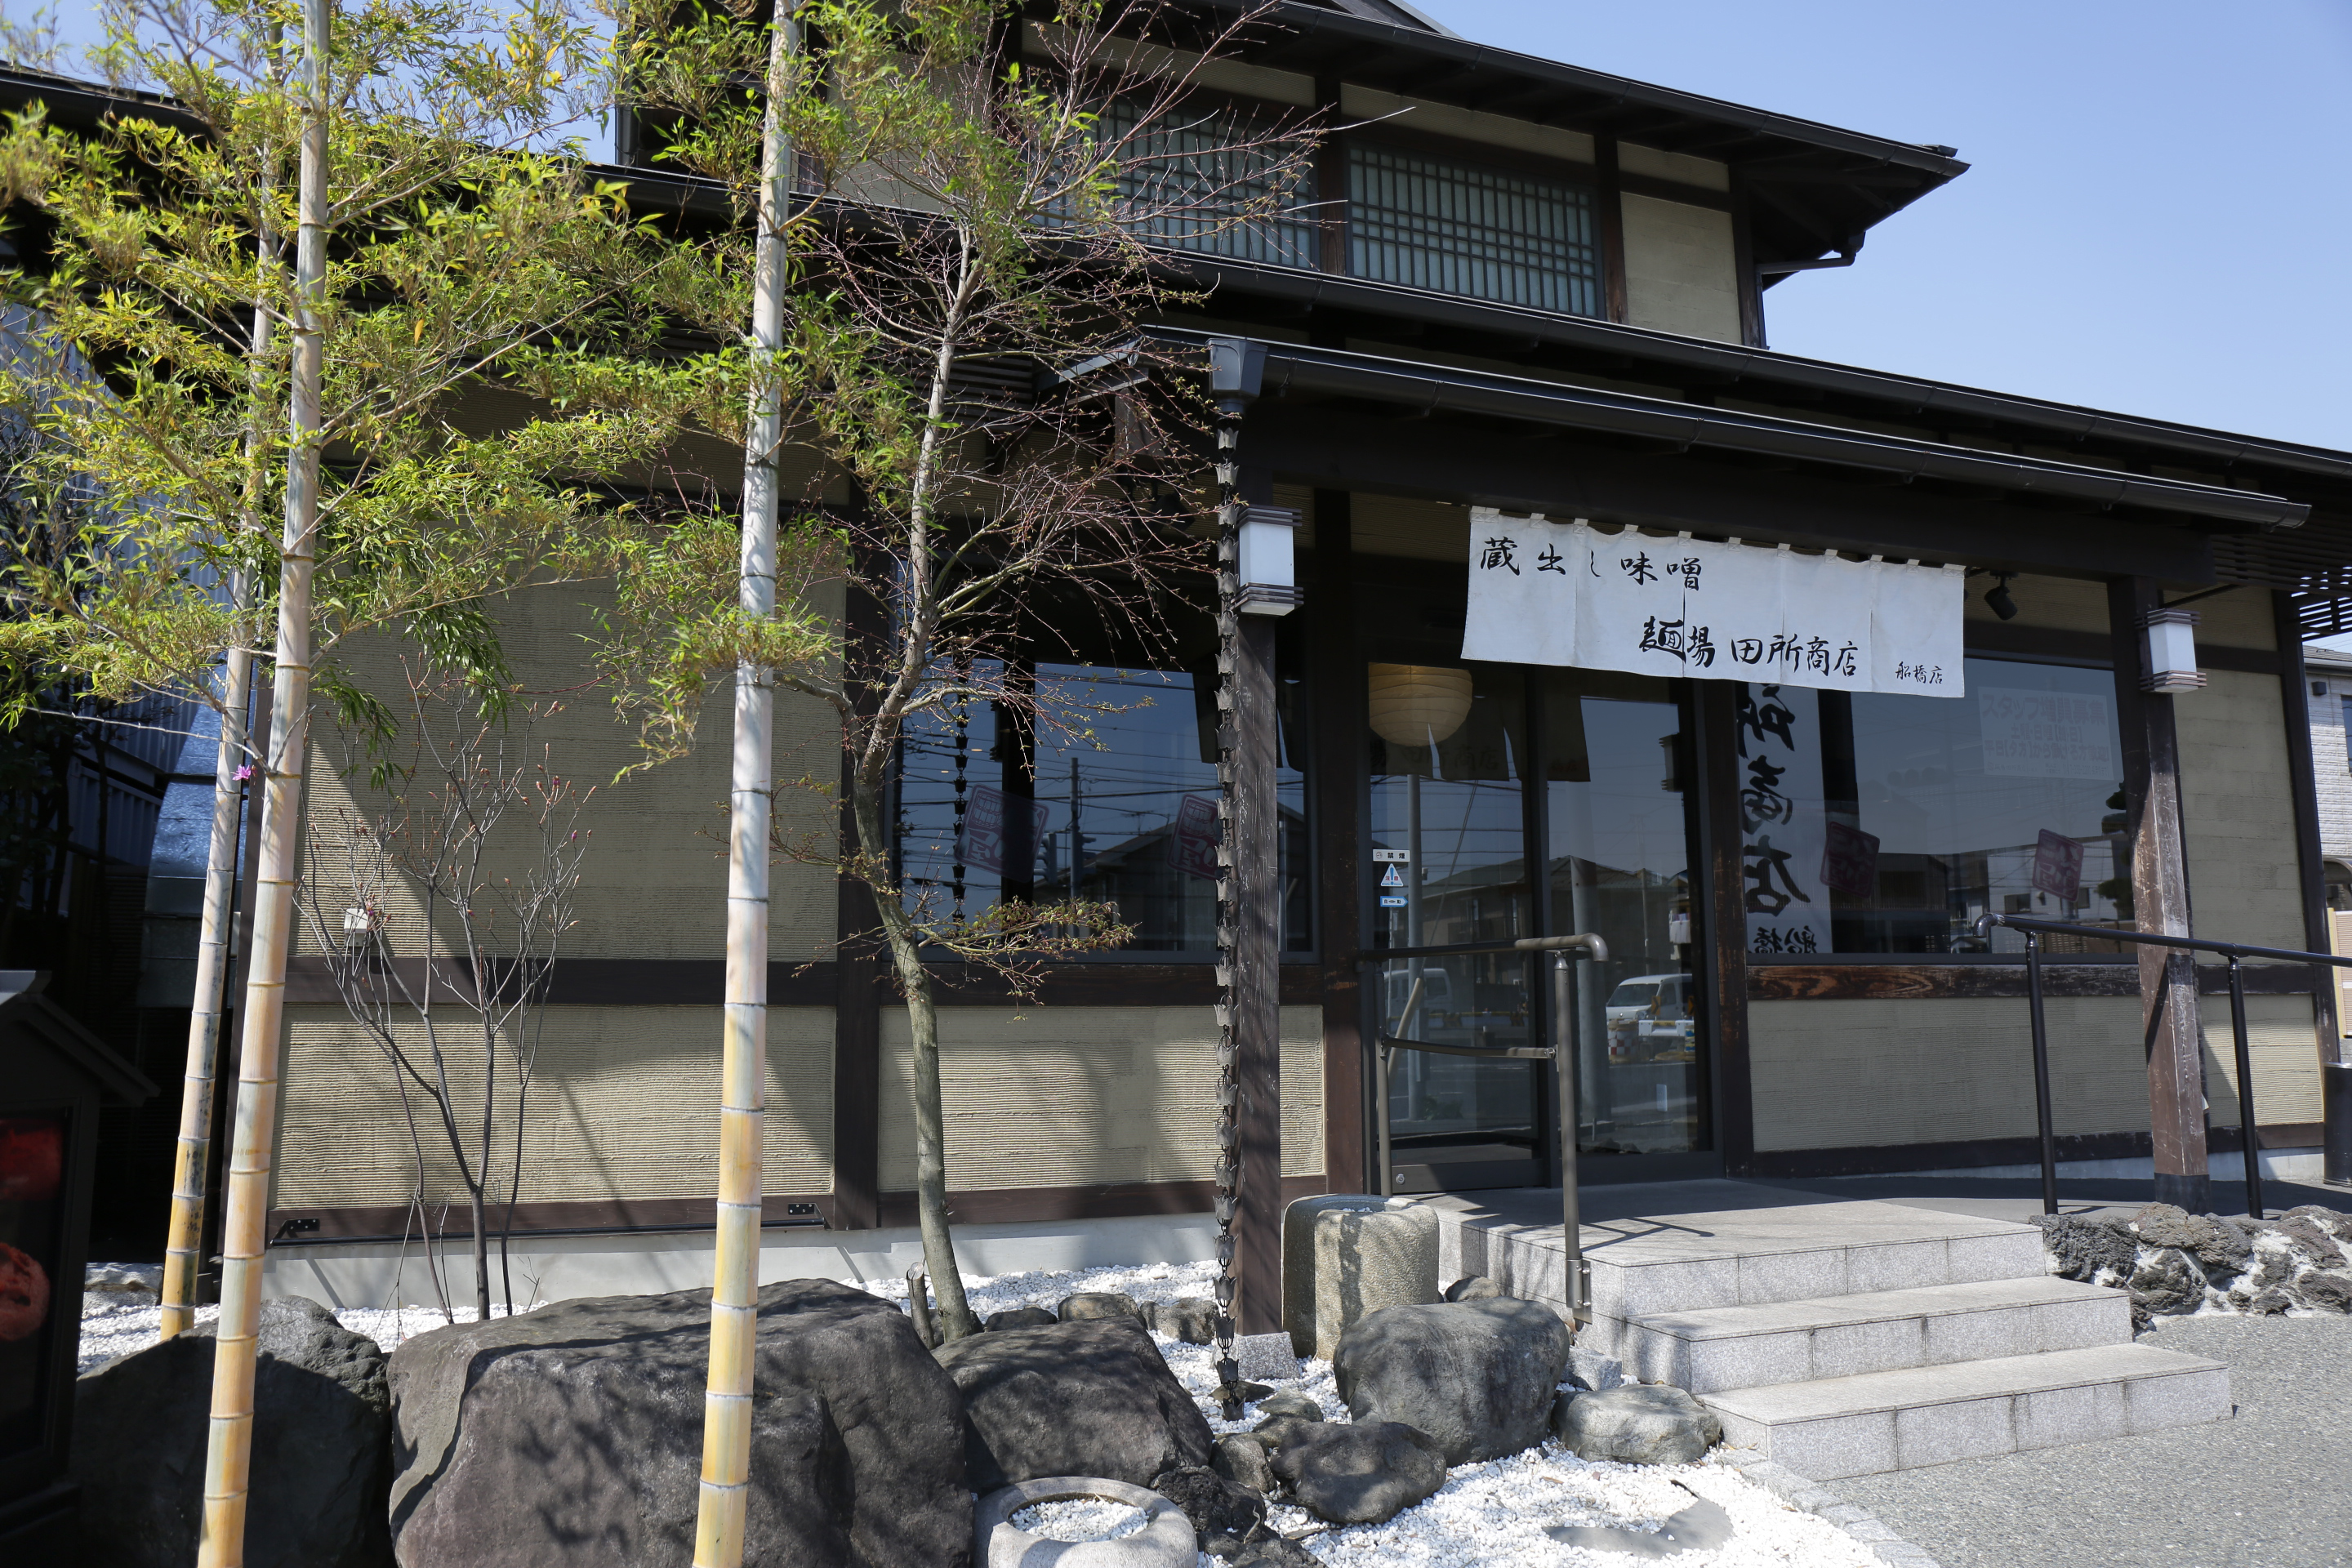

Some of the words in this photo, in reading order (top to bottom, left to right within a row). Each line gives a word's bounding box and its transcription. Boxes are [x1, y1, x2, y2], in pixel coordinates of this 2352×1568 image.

[1480, 536, 1702, 591] 蔵出し味噌
[1895, 662, 1943, 684] 船橋店
[1981, 694, 2106, 726] スタッフ増員募集
